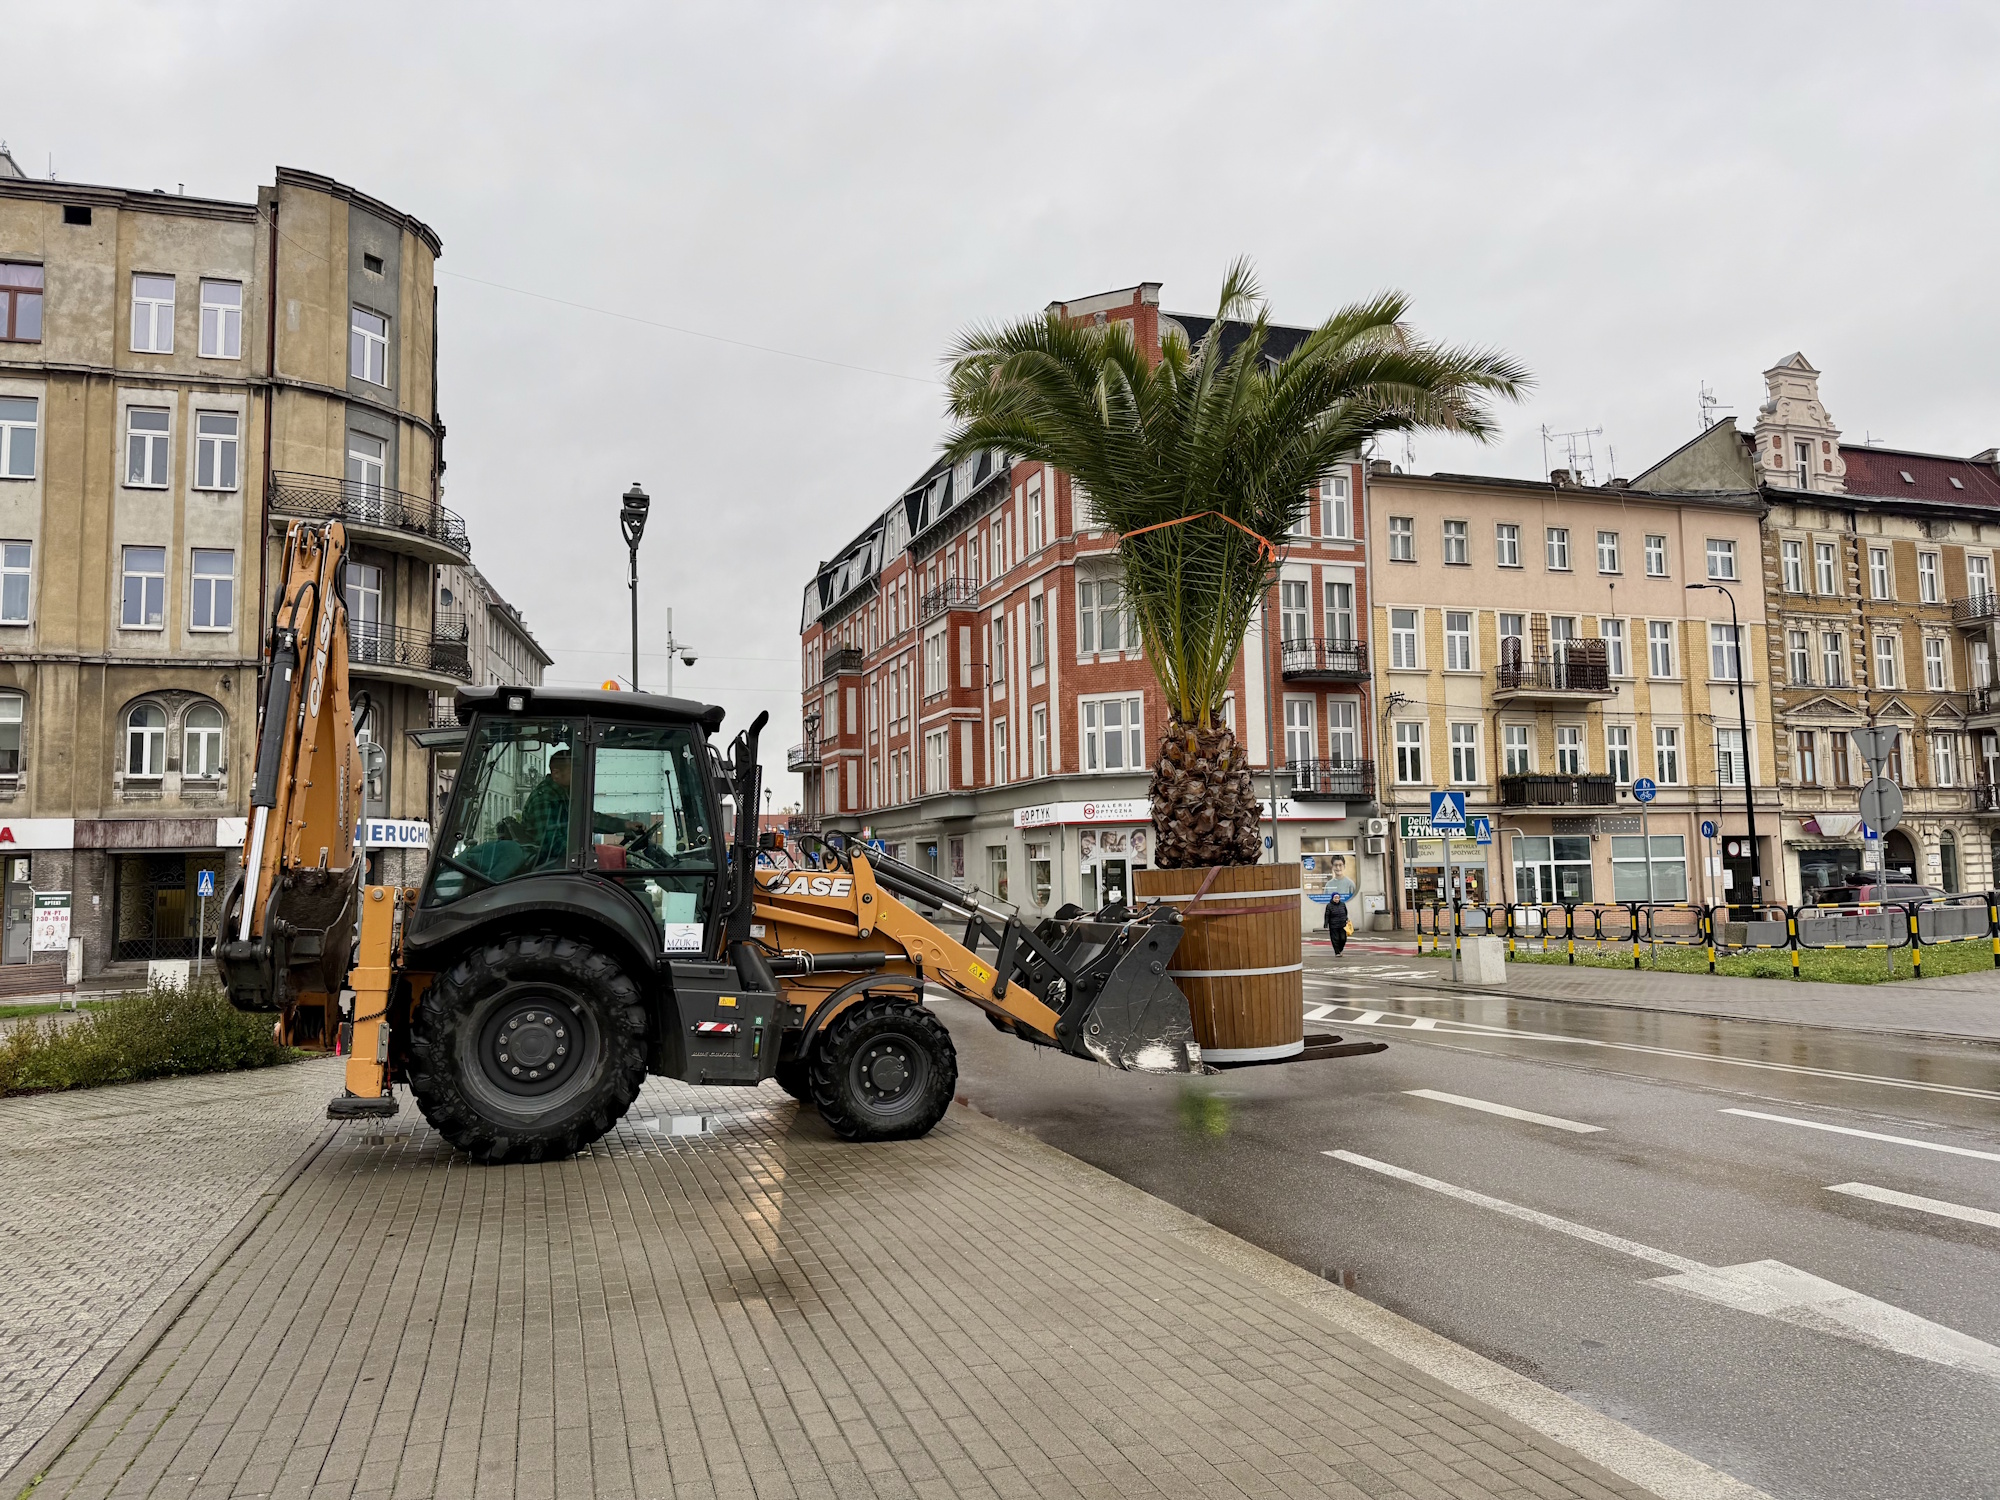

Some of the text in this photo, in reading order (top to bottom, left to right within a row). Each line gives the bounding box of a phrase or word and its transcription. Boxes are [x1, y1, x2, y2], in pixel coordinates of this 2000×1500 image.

[310, 578, 335, 718] CASE
[1025, 808, 1050, 821] OPTYK
[1408, 816, 1432, 826] Delik
[766, 875, 853, 898] CASE
